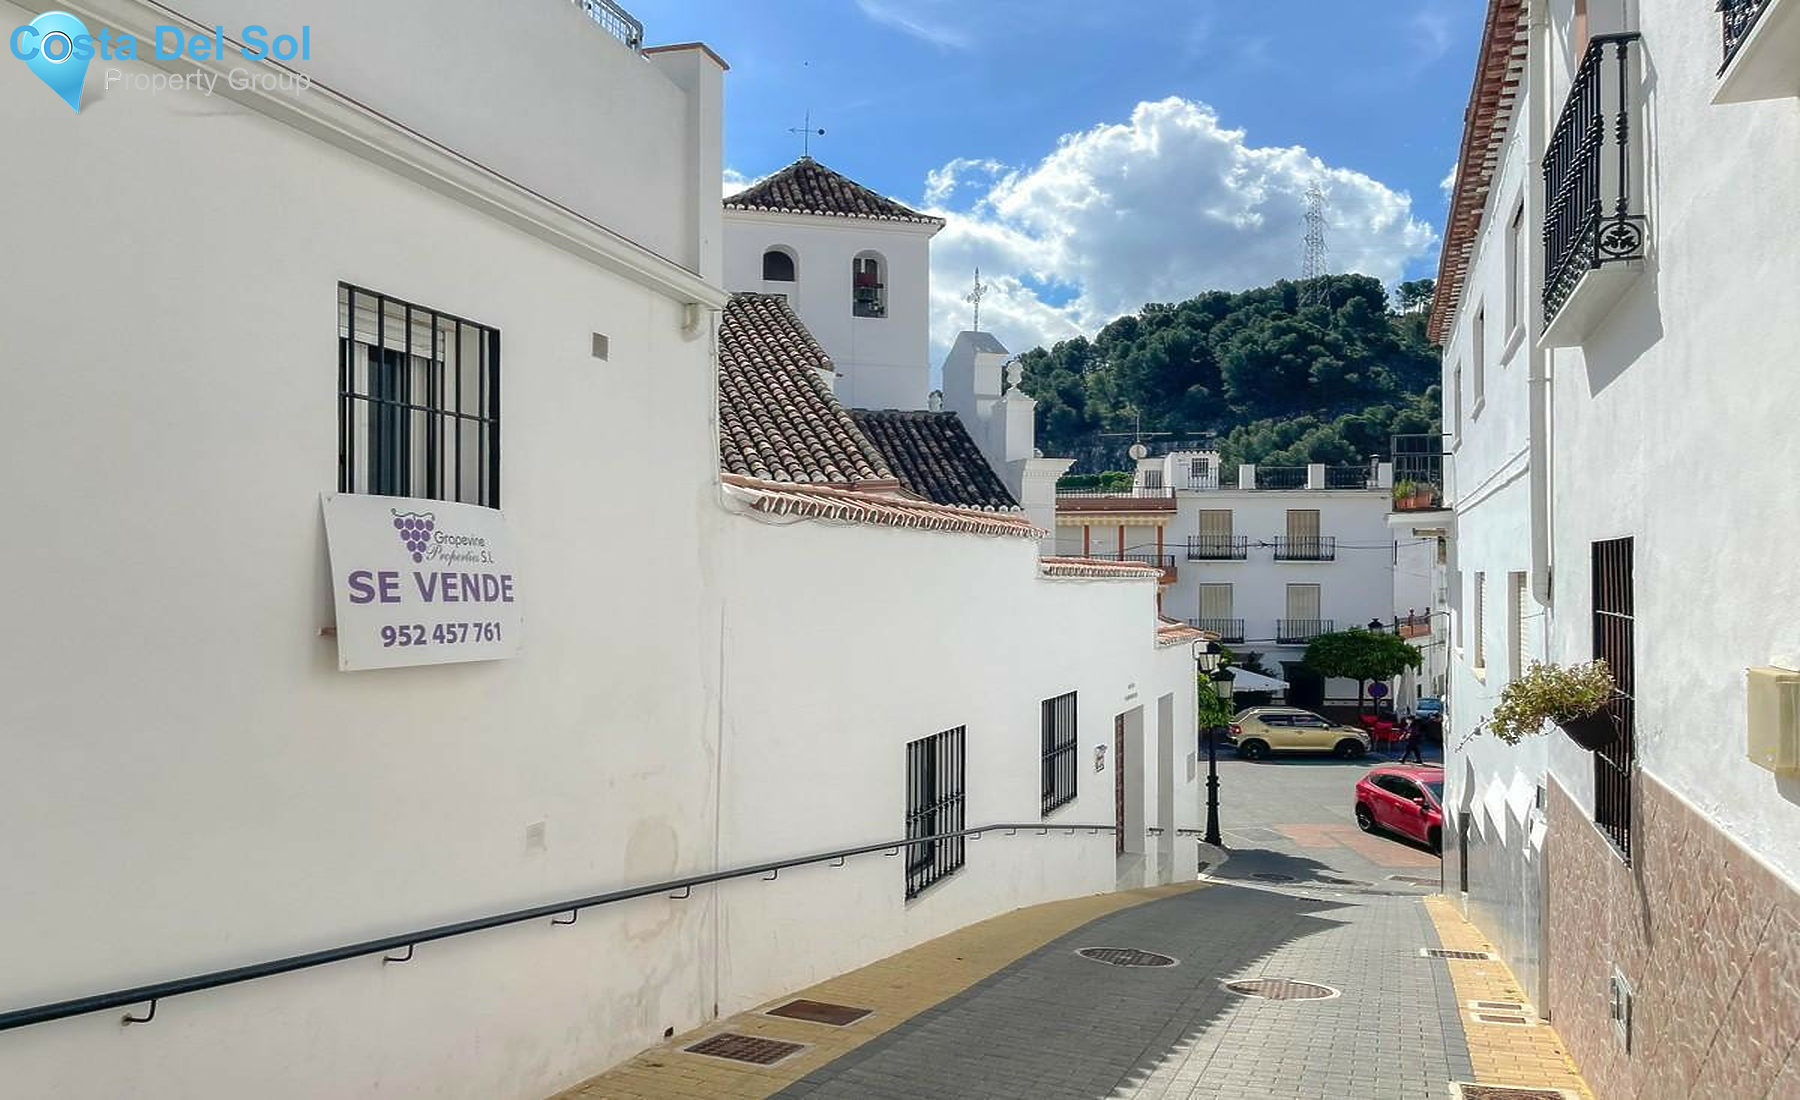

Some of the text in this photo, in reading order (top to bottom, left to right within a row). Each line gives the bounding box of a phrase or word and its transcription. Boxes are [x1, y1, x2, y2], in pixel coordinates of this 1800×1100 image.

[434, 530, 486, 548] Grapevine
[425, 543, 481, 566] Properties
[348, 570, 514, 604] SE VENDE
[381, 621, 501, 648] 952 457 761
